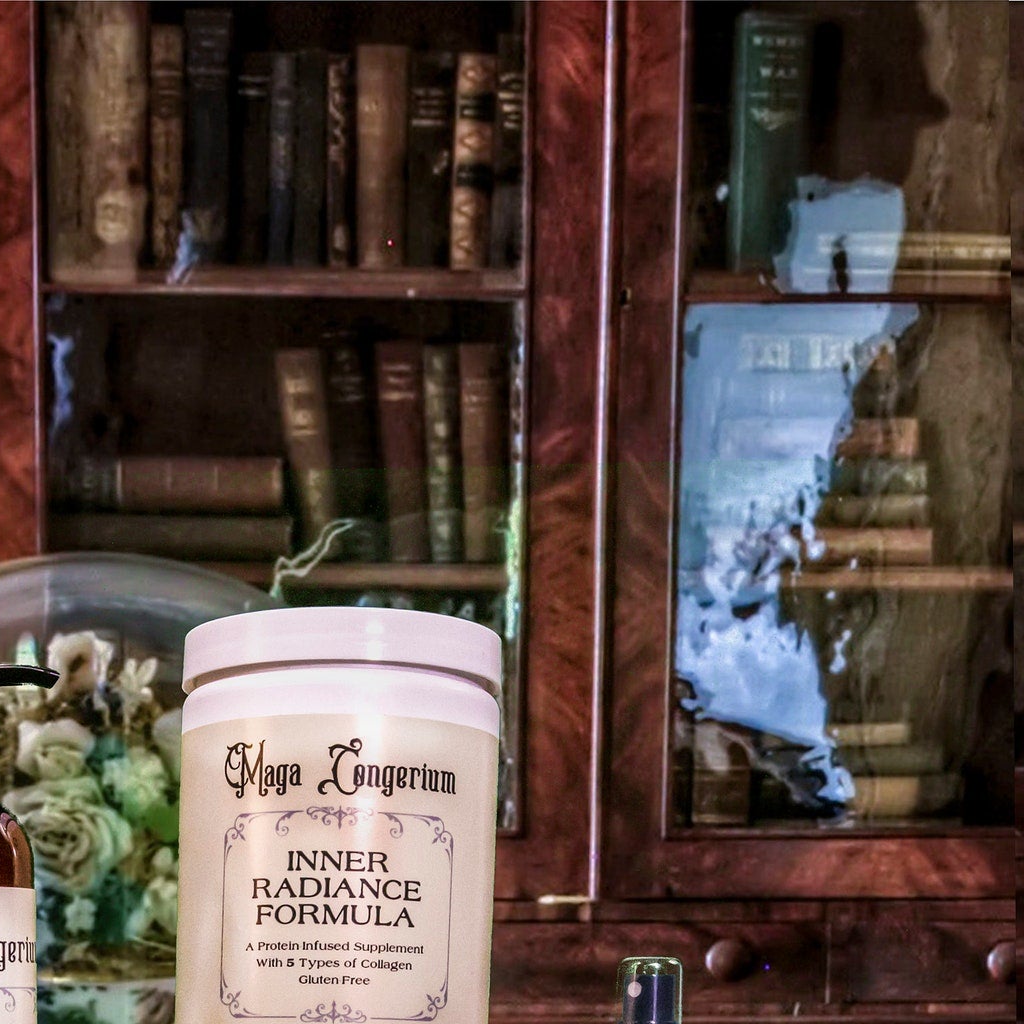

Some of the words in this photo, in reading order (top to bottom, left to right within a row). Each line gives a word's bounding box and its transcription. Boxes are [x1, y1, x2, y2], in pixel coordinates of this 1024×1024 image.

[224, 739, 302, 798] Maga
[287, 851, 388, 873] INNER
[252, 878, 421, 901] RADIANCE
[255, 904, 414, 927] FORMULA
[246, 942, 254, 951] A
[258, 941, 299, 951] Protein
[302, 940, 349, 951] Infused
[354, 941, 424, 954] Supplement
[256, 958, 282, 968] With
[286, 959, 294, 967] 5
[299, 958, 340, 971] Types
[344, 958, 357, 967] of
[361, 959, 412, 972] Collagen
[299, 975, 339, 985] Gluten
[342, 975, 370, 985] Free
